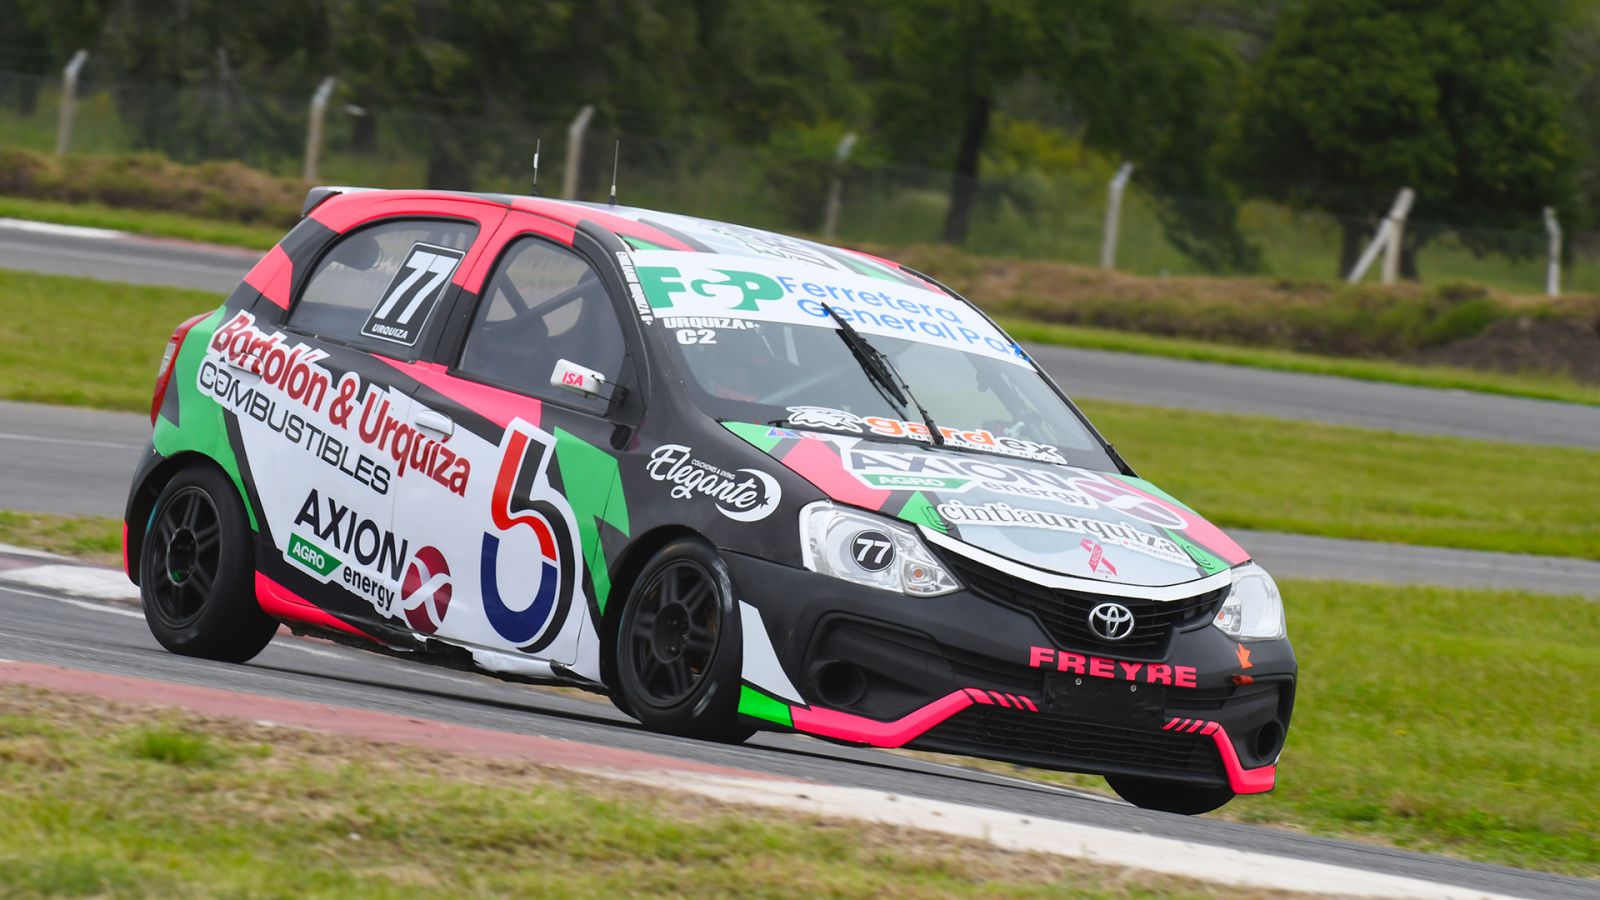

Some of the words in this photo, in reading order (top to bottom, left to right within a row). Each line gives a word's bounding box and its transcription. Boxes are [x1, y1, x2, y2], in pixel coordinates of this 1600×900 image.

[374, 250, 459, 325] 77
[635, 266, 784, 312] FGP
[776, 275, 963, 324] Ferretera
[371, 323, 409, 340] URQUIZA
[663, 317, 746, 330] URQUIZA
[676, 328, 718, 345] C2
[797, 298, 957, 341] General
[211, 314, 328, 413] Bortolón
[329, 377, 356, 430] &
[562, 371, 584, 387] ISA
[200, 361, 391, 496] COMBUSTIBLES
[863, 417, 1060, 459] gardex
[646, 444, 758, 508] Elegante
[849, 451, 1076, 492] AXION
[878, 475, 946, 487] AGRO
[981, 481, 1091, 506] energy
[294, 488, 409, 582] AXION
[941, 501, 1187, 558] cintiaurquiza
[292, 541, 326, 570] AGRO
[856, 538, 891, 564] 77
[343, 562, 396, 612] energy
[1029, 646, 1197, 688] FREYRE
